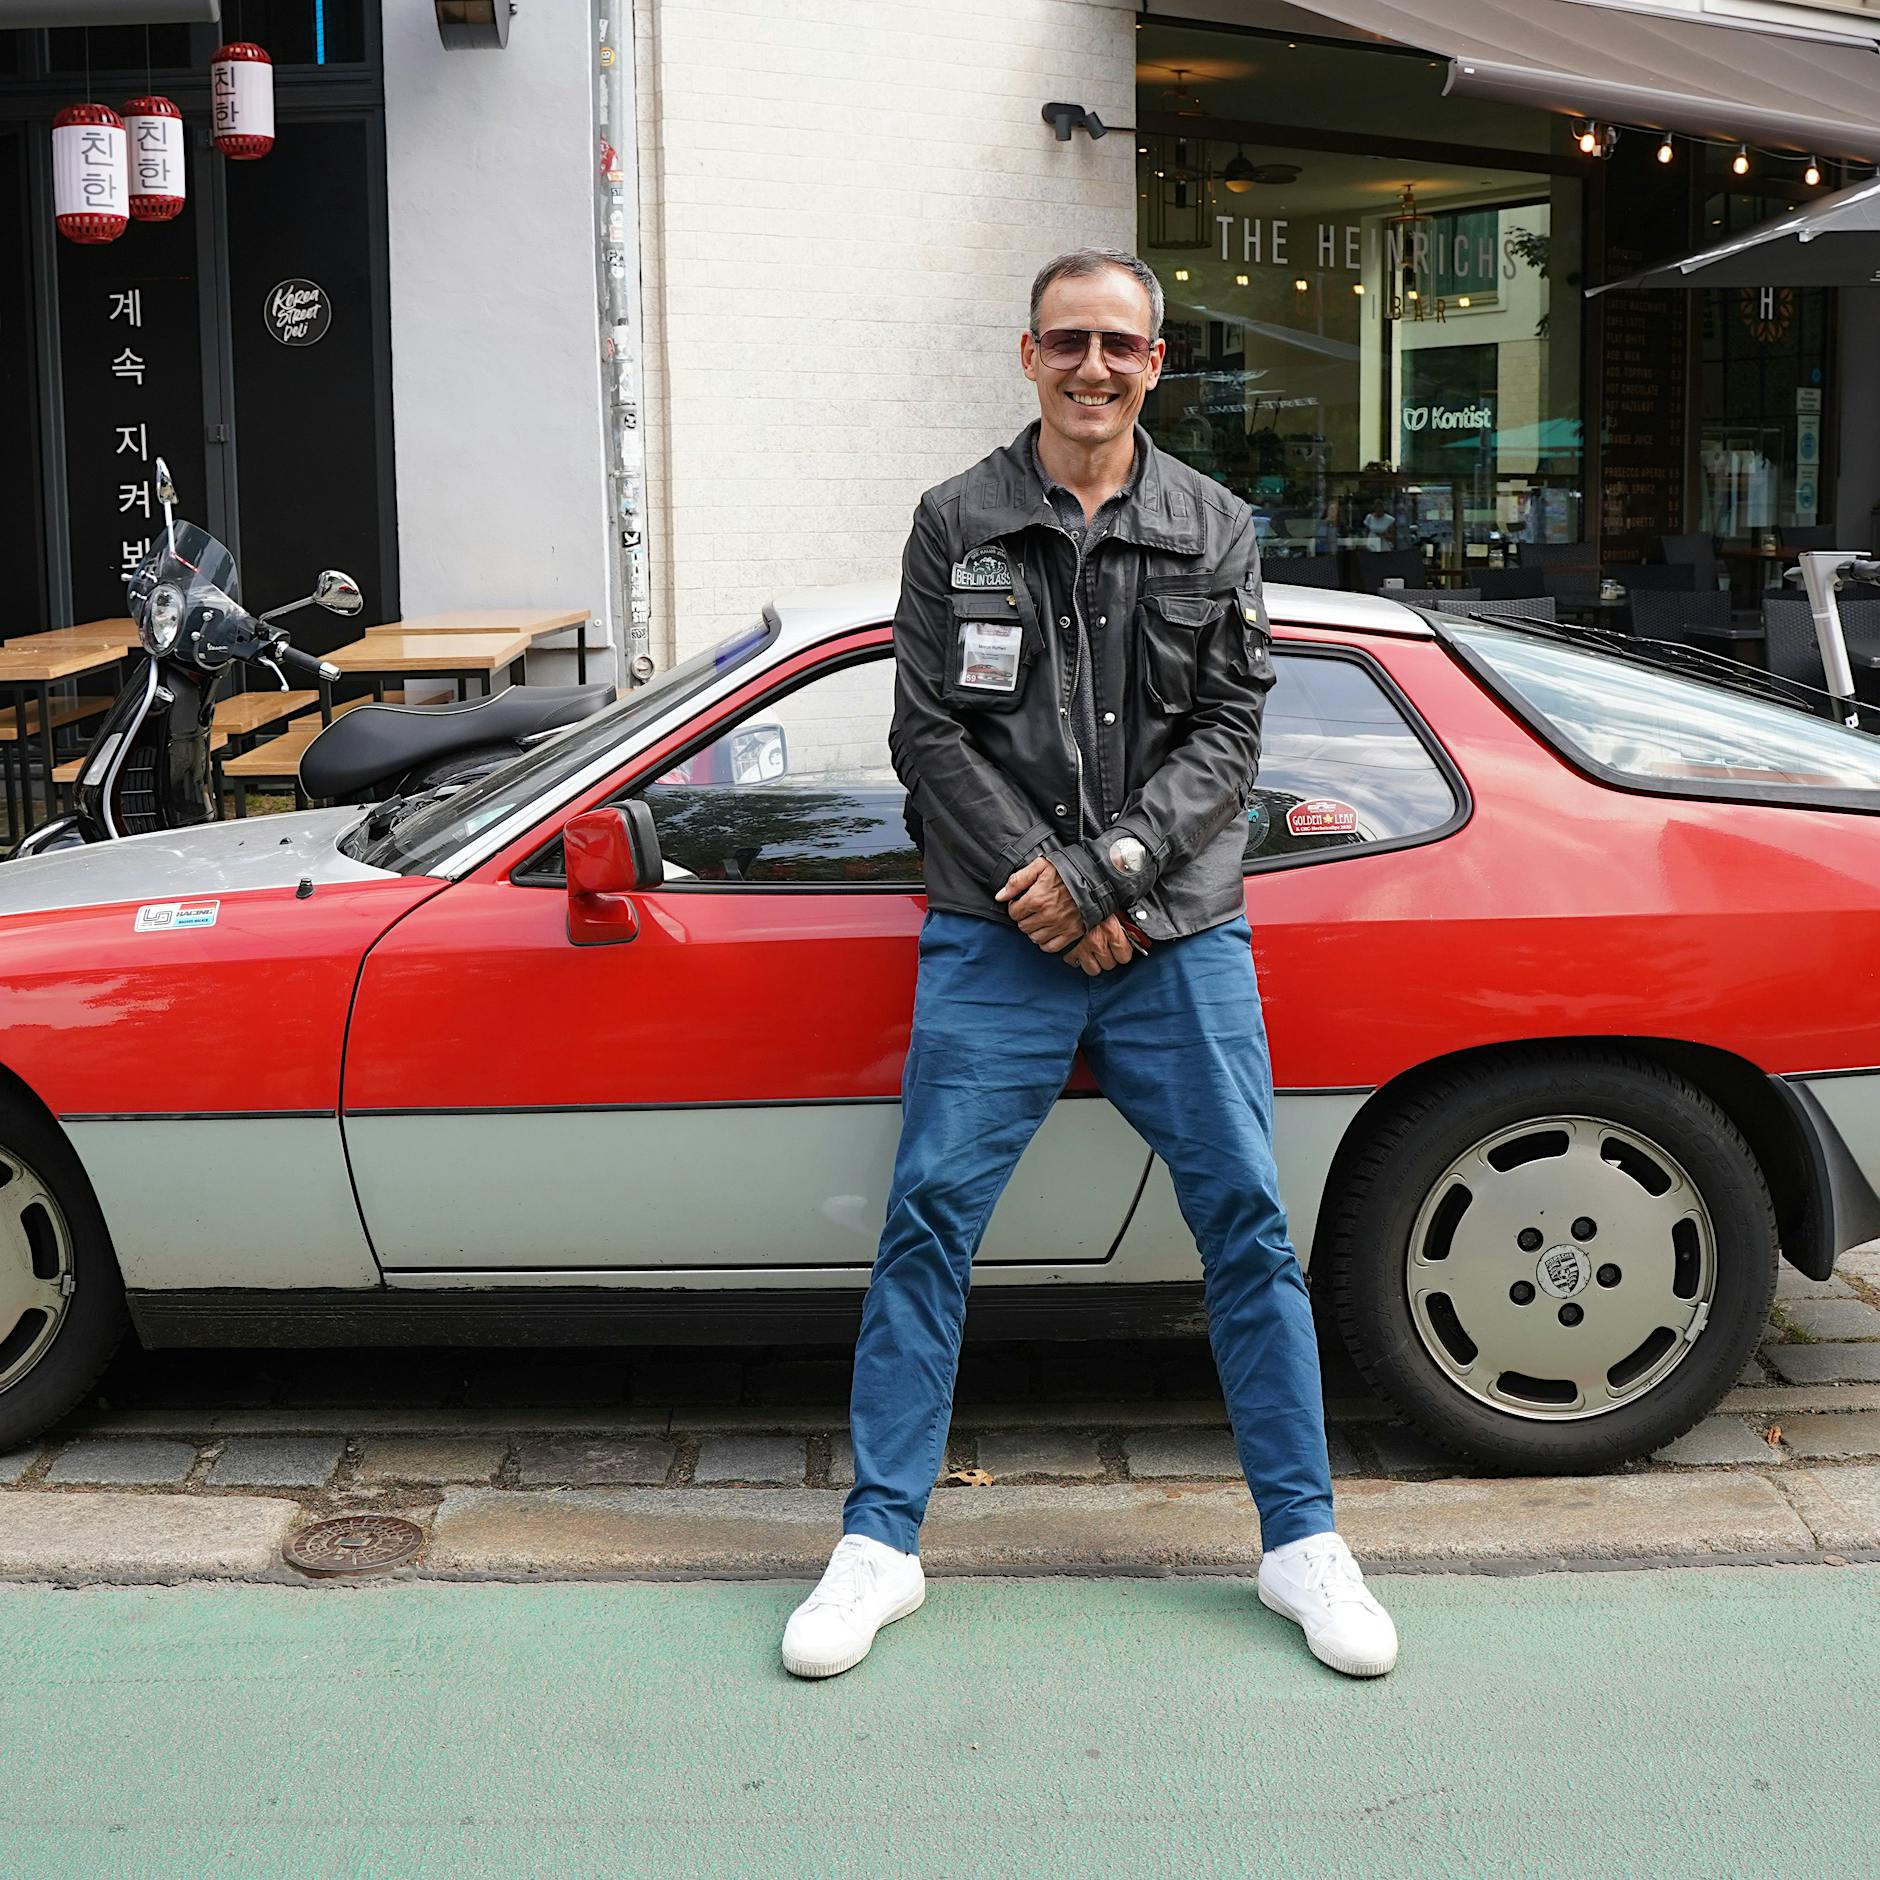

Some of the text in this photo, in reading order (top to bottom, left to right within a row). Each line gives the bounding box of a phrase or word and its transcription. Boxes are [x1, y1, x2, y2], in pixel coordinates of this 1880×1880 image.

[137, 120, 171, 190] 친한
[80, 131, 117, 209] 친한
[1216, 215, 1517, 280] THE HEINRICHS
[1392, 295, 1447, 323] BAR
[1760, 286, 1774, 321] H
[1431, 404, 1492, 430] Kontist
[1626, 517, 1656, 529] ORETTI
[956, 569, 1011, 586] BERLIN CLASS
[1292, 814, 1354, 826] GOLDEN LEAF
